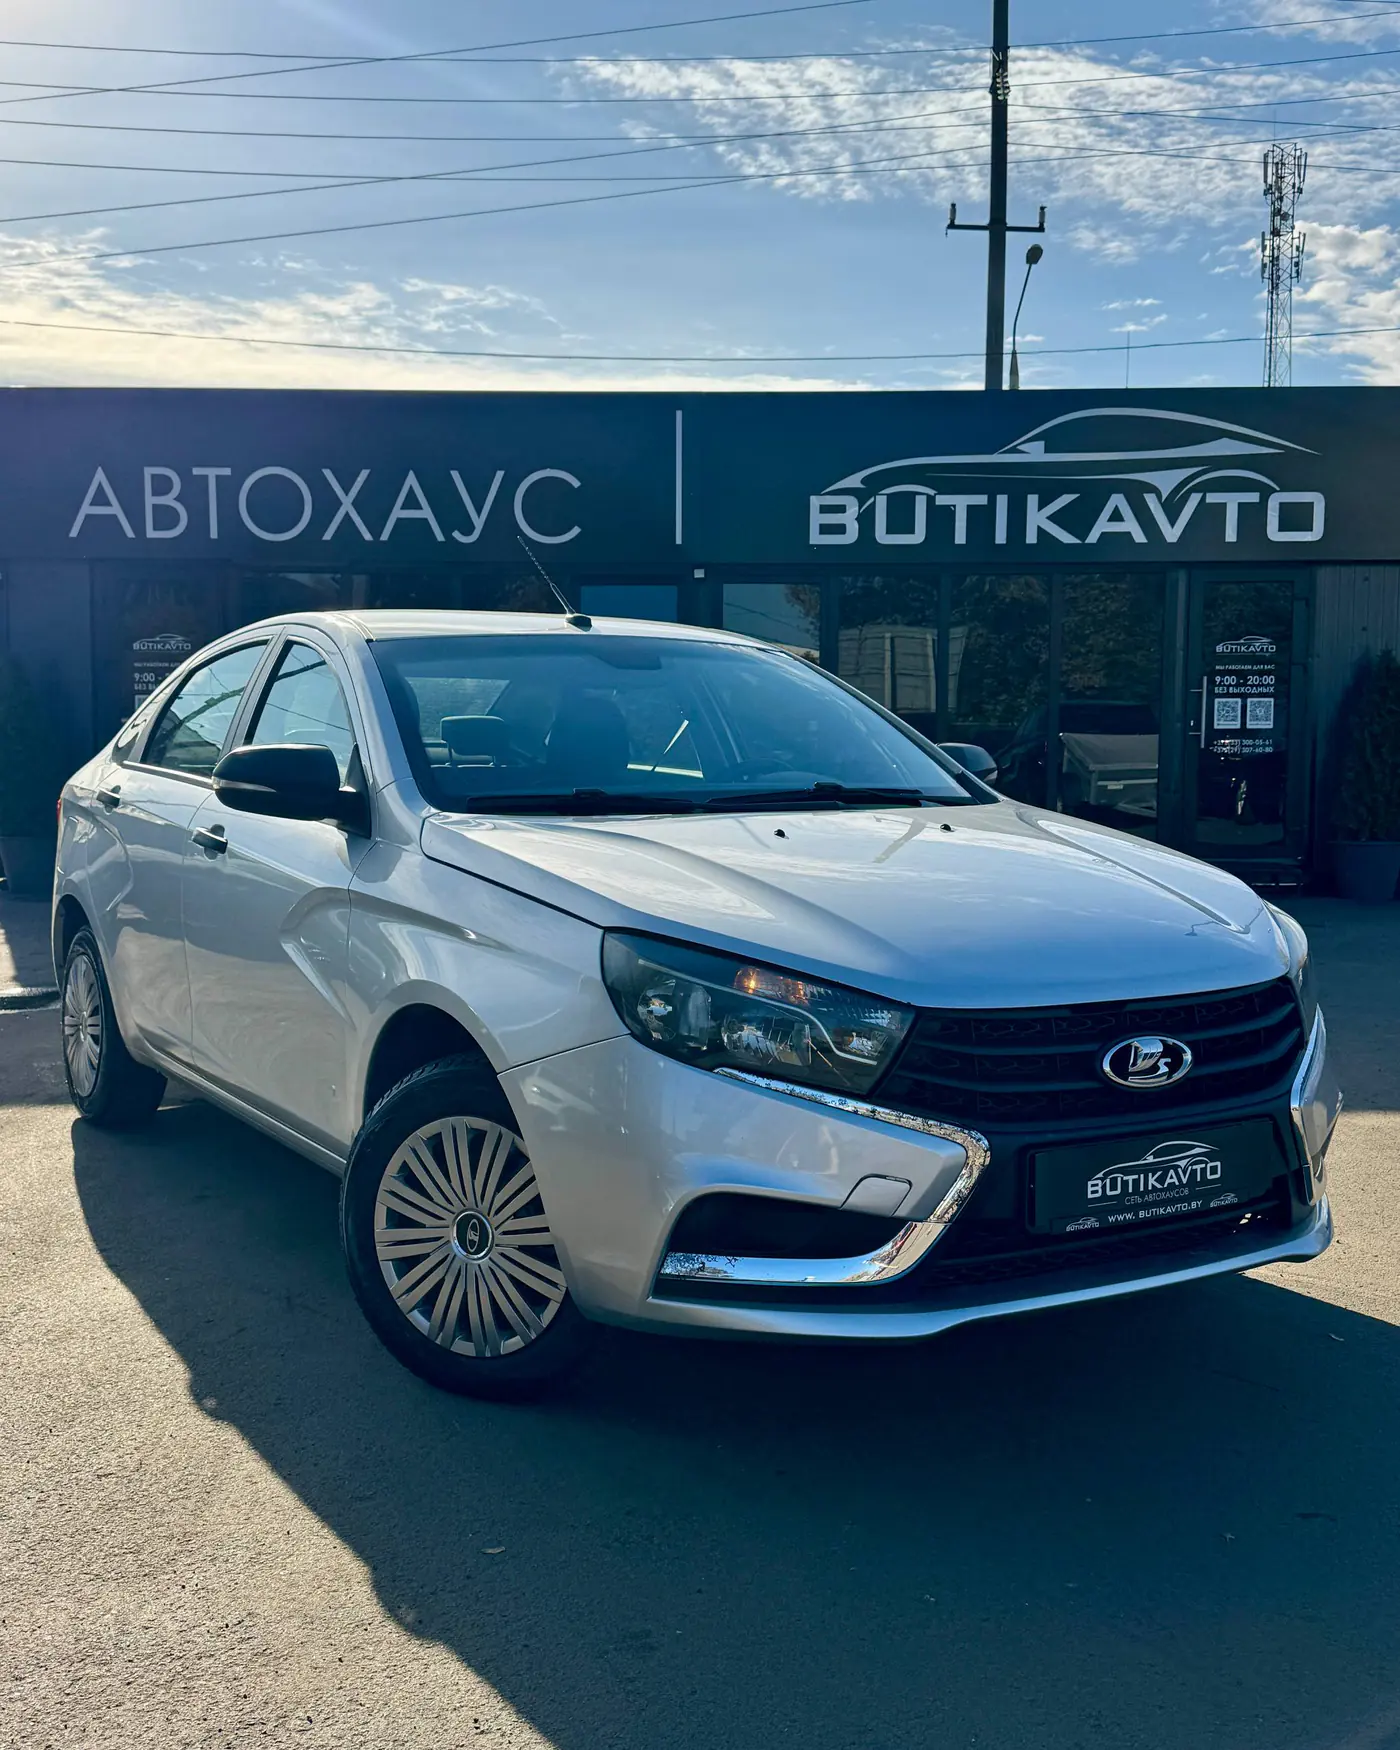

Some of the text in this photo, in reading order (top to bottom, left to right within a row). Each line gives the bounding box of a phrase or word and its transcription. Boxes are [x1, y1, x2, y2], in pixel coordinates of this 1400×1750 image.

[69, 466, 582, 544] АВТОХАУС
[809, 492, 1326, 545] BUTIKAVTO
[133, 642, 191, 650] BUTIKAVTO
[1215, 644, 1277, 653] BUTIKAVTO
[134, 673, 155, 682] 9:00
[1214, 675, 1237, 685] 9:00
[1246, 675, 1275, 685] 20:00
[1214, 686, 1275, 694] БЕЗ ВЫХОДНЫХ
[1087, 1161, 1221, 1199] BUTIKAVTO
[1124, 1188, 1190, 1205] СЕТЬ АВТОХАУСОВ
